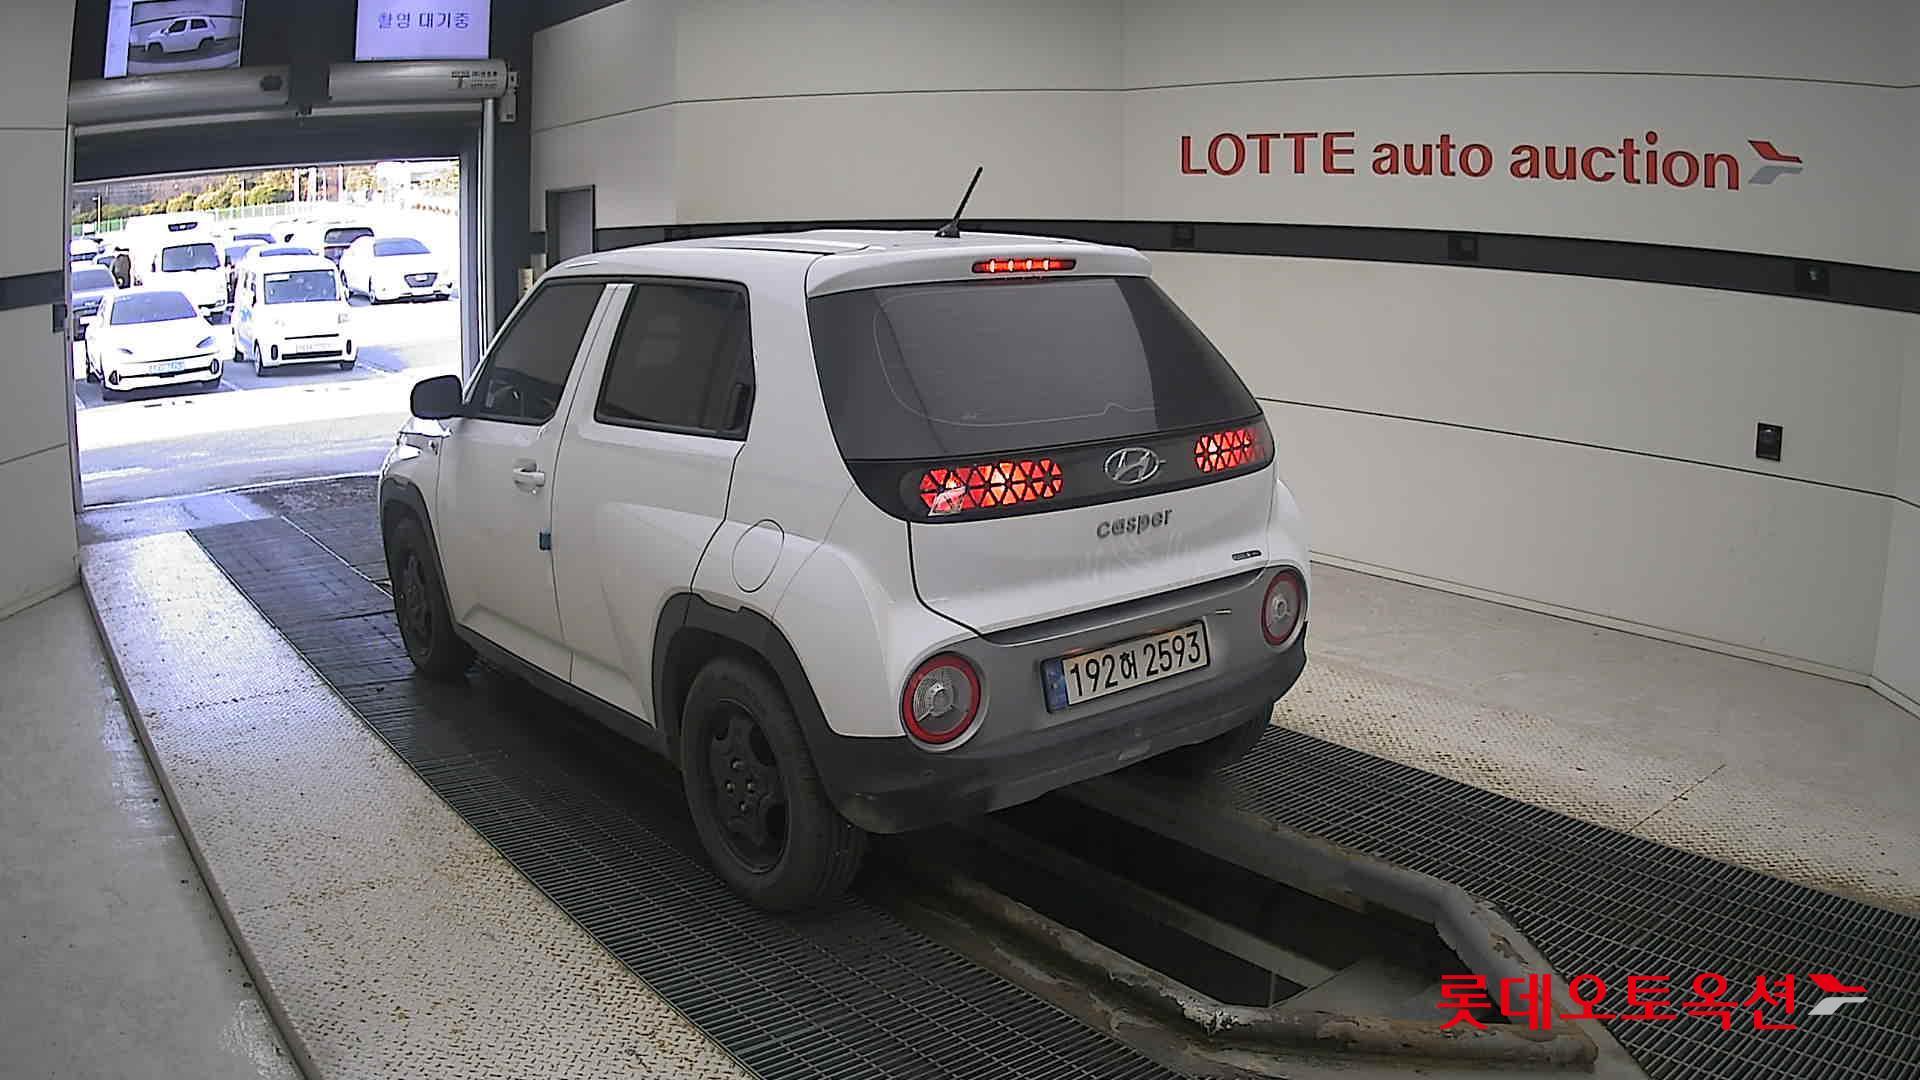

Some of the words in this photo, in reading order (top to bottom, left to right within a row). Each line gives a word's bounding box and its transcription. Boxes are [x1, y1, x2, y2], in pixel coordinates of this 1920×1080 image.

[418, 12, 469, 29] 대기중
[1180, 131, 1356, 176] LOTTE
[1371, 134, 1493, 179] auto
[1510, 131, 1741, 190] auction
[1097, 508, 1173, 539] casper
